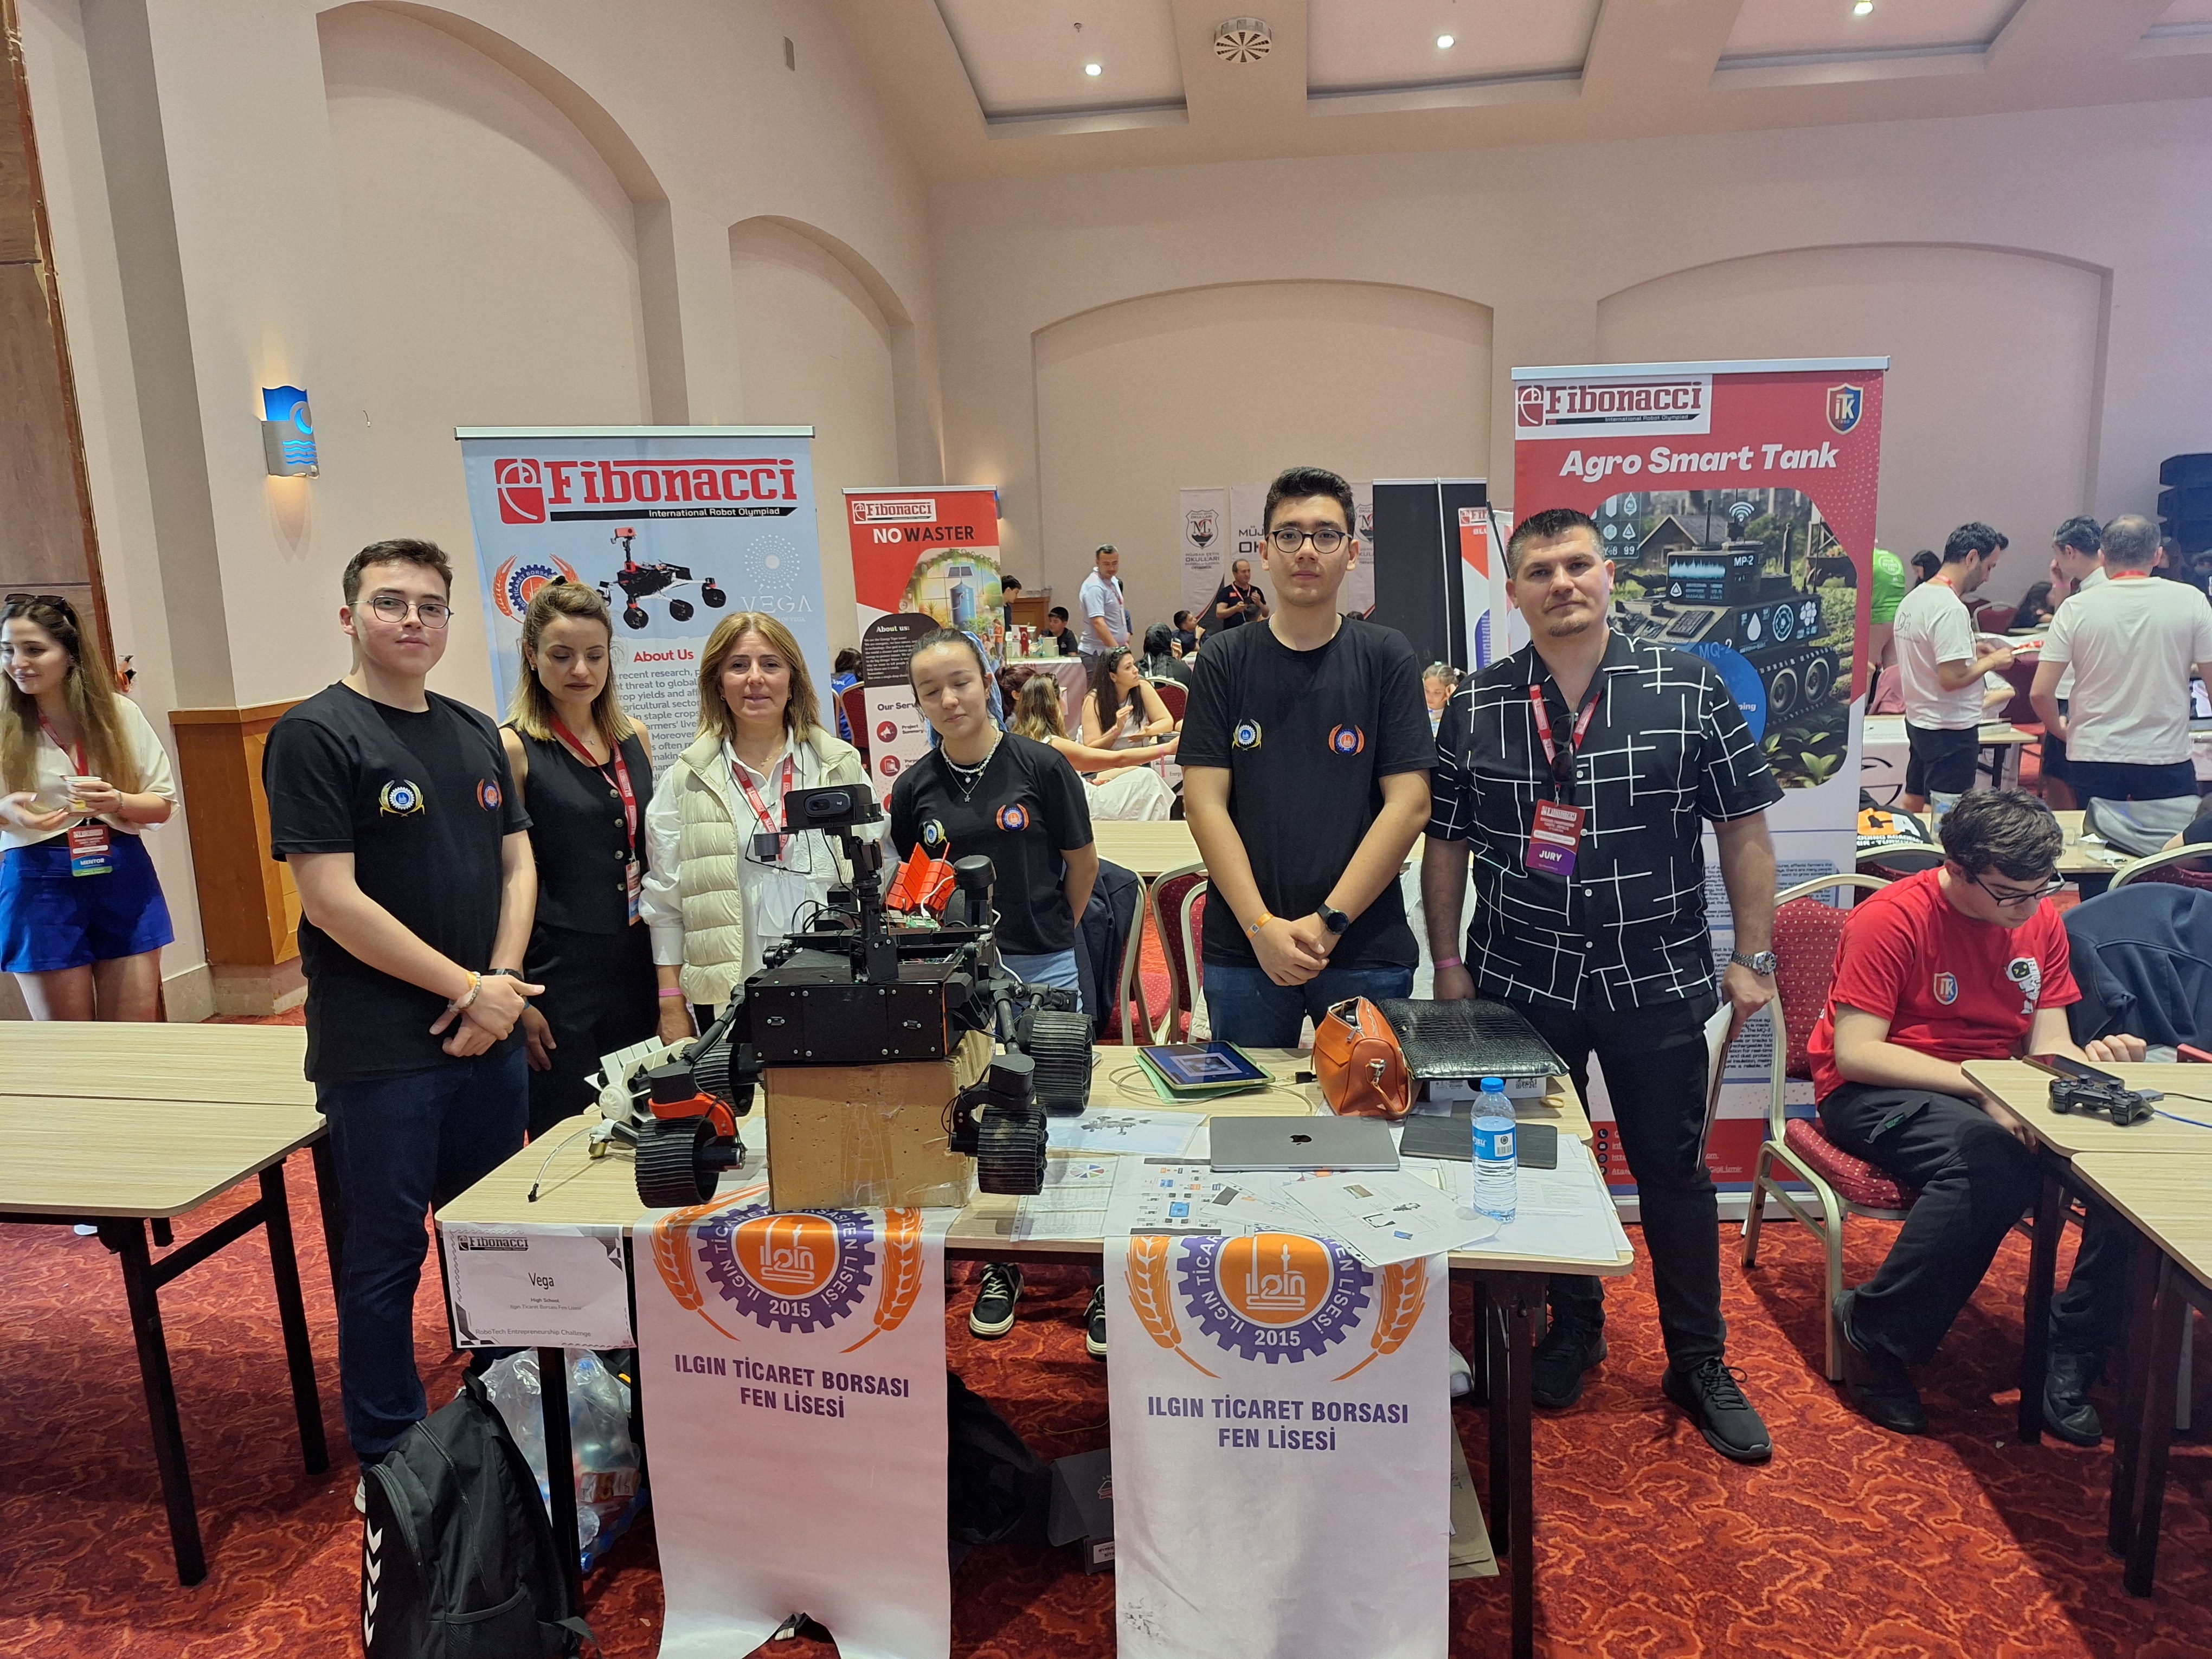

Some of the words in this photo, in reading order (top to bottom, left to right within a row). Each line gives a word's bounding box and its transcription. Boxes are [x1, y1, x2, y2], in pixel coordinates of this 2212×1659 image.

[1546, 381, 1702, 414] Fibonacci
[1559, 450, 1642, 483] Agro
[1648, 446, 1754, 473] Smart
[1761, 442, 1840, 470] Tank
[543, 458, 798, 505] Fibonacci
[649, 509, 708, 517] International
[709, 508, 736, 516] Robot
[738, 507, 781, 517] Olympiad
[866, 501, 931, 516] Fibonacci
[873, 528, 902, 544] NO
[904, 525, 975, 542] WASTER
[1238, 525, 1264, 537] MÜJ
[633, 650, 674, 663] About
[677, 649, 694, 660] Us
[1699, 639, 1733, 660] MQ-2
[619, 670, 649, 679] recent
[651, 668, 693, 678] research,
[626, 680, 653, 690] threat
[667, 679, 697, 689] global
[638, 691, 665, 702] yields
[623, 699, 670, 712] gricultural
[633, 712, 642, 721] in
[644, 711, 672, 721] staple
[658, 742, 682, 750] often
[652, 753, 678, 761] makin
[80, 858, 105, 866] MENTOR
[1539, 850, 1562, 862] JURY
[469, 1236, 529, 1248] Fibonacci
[841, 1221, 858, 1250] FEN
[528, 1272, 555, 1290] Vega
[719, 1259, 761, 1302] ILGIN
[820, 1255, 860, 1309] LİSESİ
[768, 1300, 812, 1318] 2015
[1201, 1290, 1246, 1334] ILGIN
[1311, 1277, 1355, 1335] LİSESİ
[561, 1329, 591, 1338] Challenge
[1254, 1329, 1301, 1346] 2015
[674, 1354, 727, 1377] ILGIN
[732, 1356, 815, 1388] TİCARET
[822, 1371, 910, 1398] BORSASI
[740, 1386, 777, 1410] FEN
[784, 1390, 845, 1418] LİSESİ
[1147, 1396, 1204, 1418] ILGIN
[1211, 1394, 1304, 1420] TİCARET
[1311, 1401, 1409, 1424] BORSASI
[1218, 1428, 1259, 1448] FEN
[1268, 1425, 1336, 1451] LİSESİ
